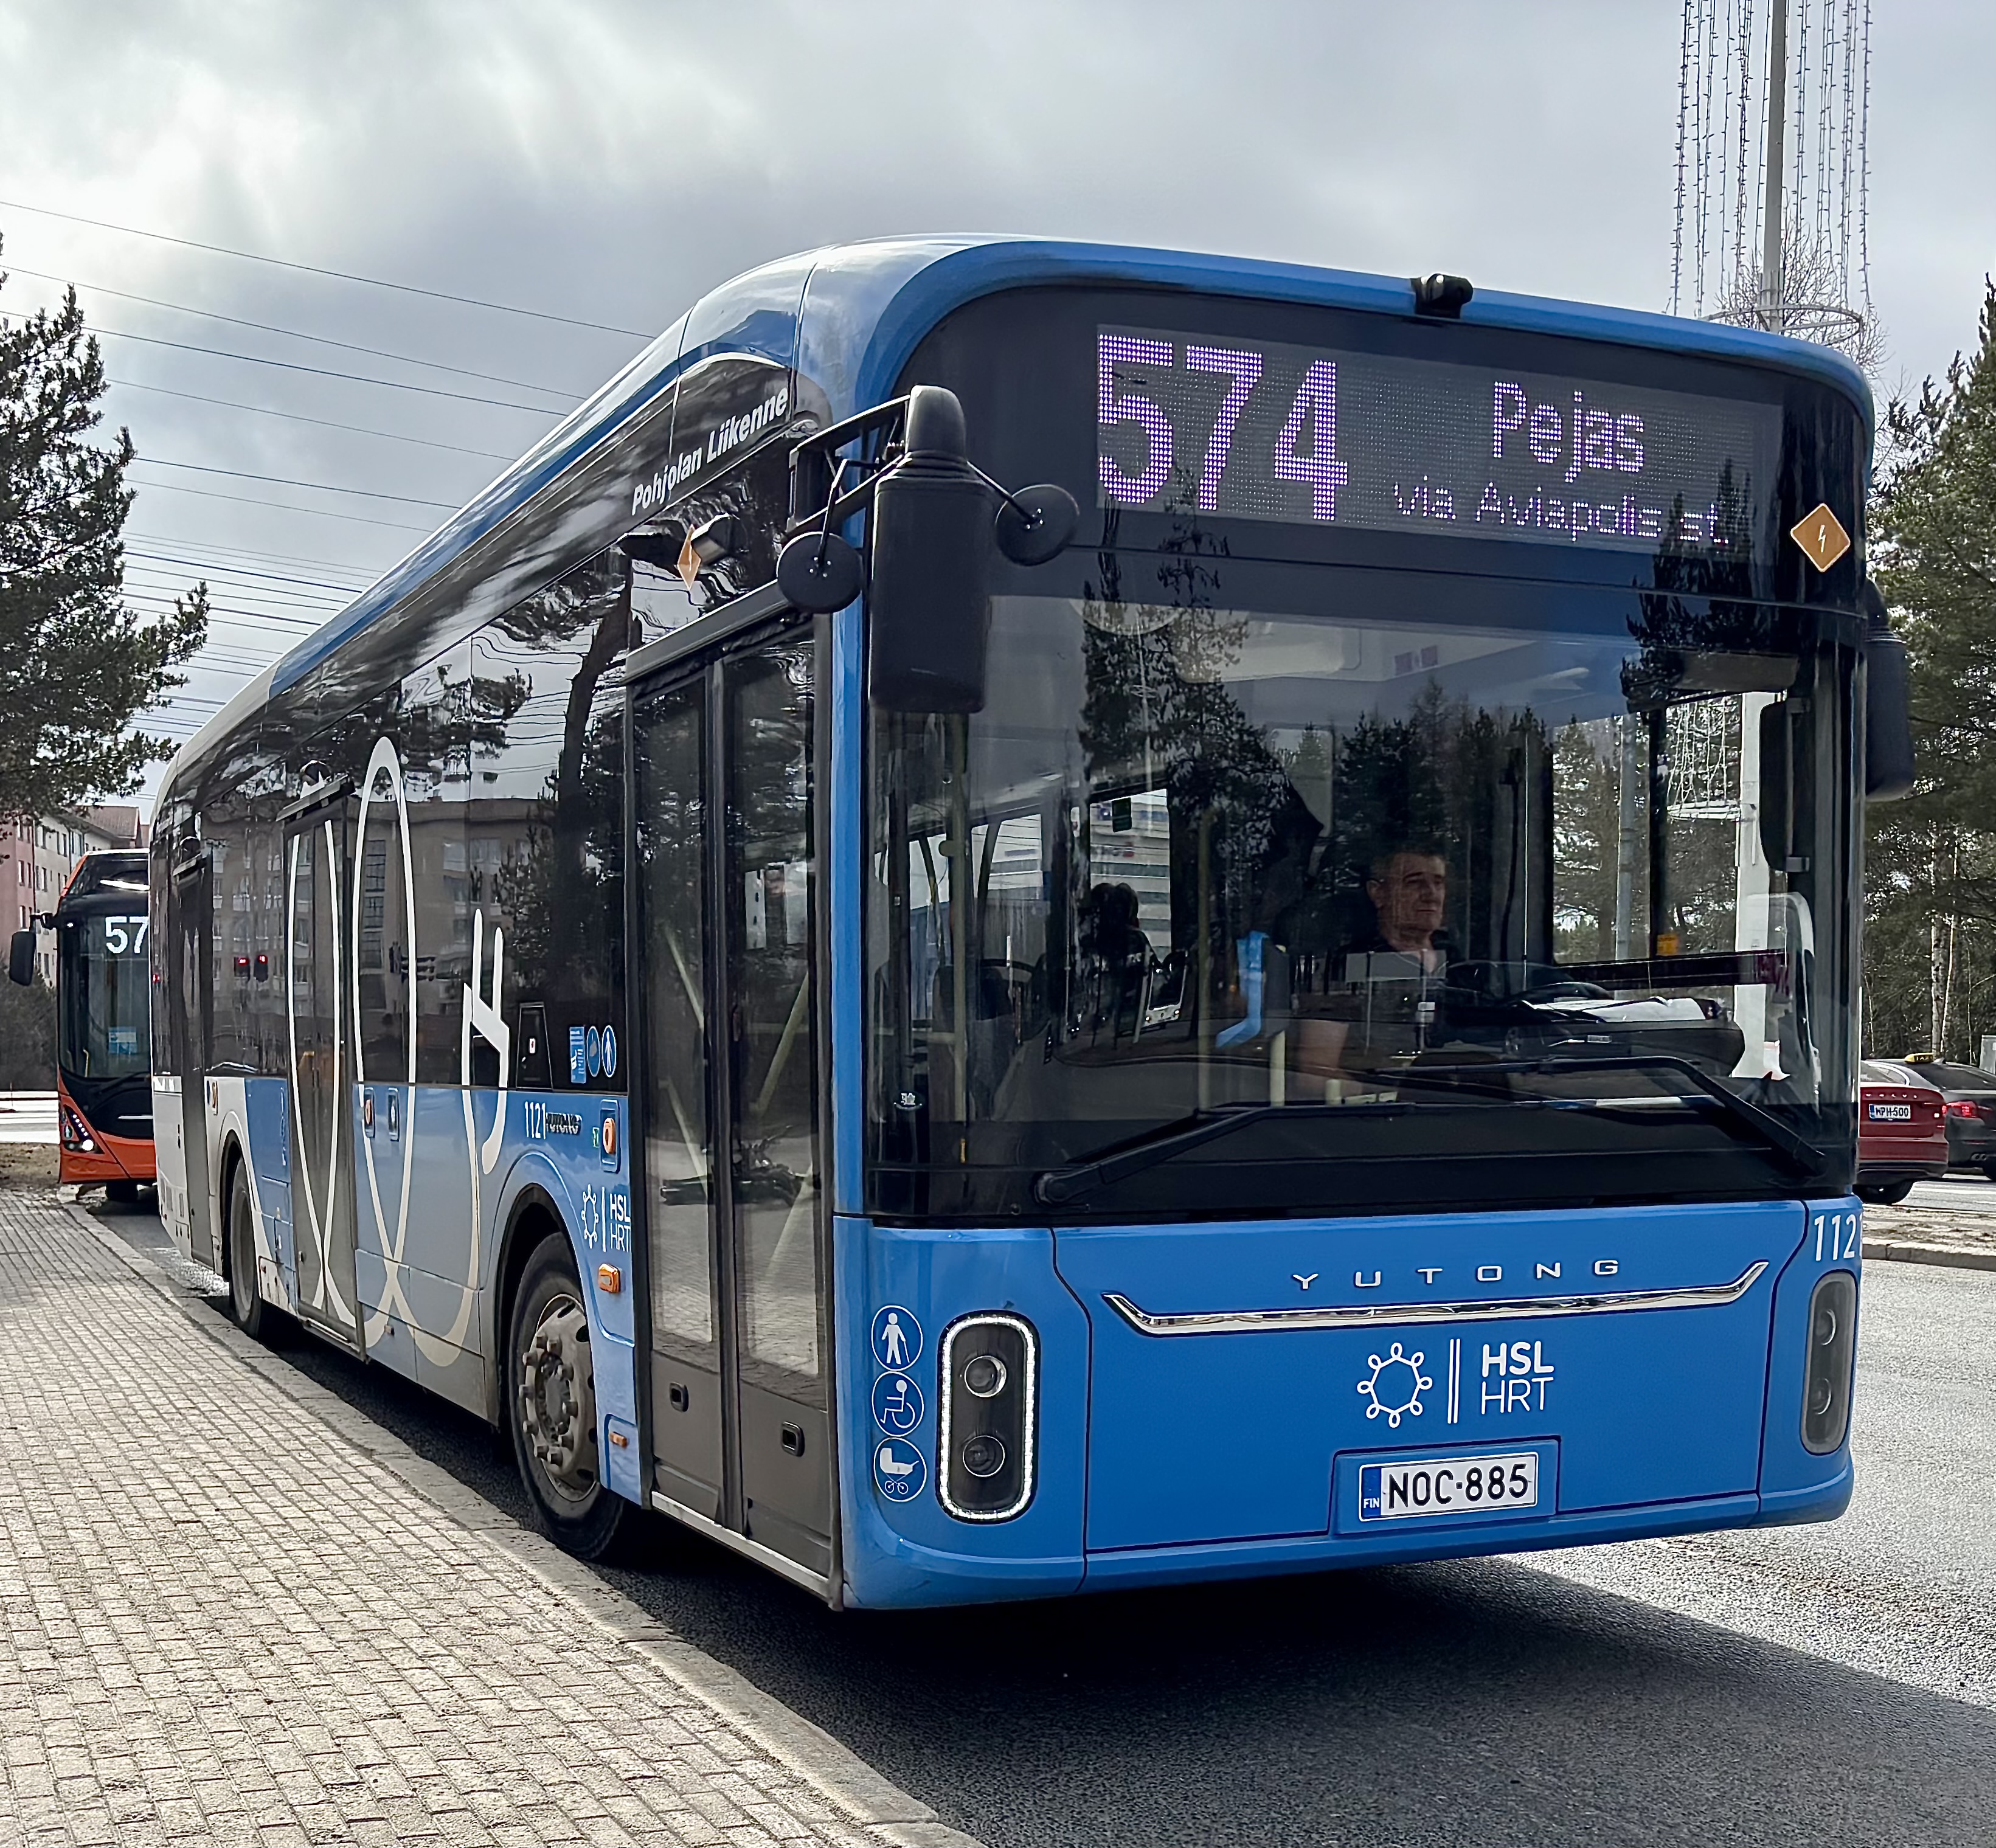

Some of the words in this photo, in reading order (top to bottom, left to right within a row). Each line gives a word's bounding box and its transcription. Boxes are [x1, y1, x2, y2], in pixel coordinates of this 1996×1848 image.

[1098, 333, 1348, 521] 574
[1493, 381, 1645, 483] Pejas
[631, 447, 702, 516] Pohjolan
[707, 387, 788, 463] Liikenne
[1393, 476, 1457, 521] via
[1475, 483, 1662, 542] Aviapolis
[105, 916, 150, 953] 57
[524, 1101, 546, 1140] 1121
[610, 1193, 631, 1222] HSL
[610, 1223, 631, 1253] HRT
[1814, 1212, 1862, 1261] 112
[1293, 1259, 1618, 1289] YUTONG
[1481, 1340, 1554, 1377] HSL
[1481, 1377, 1554, 1414] HRT
[1364, 1497, 1380, 1509] FIN
[1388, 1463, 1528, 1509] NOC-885
